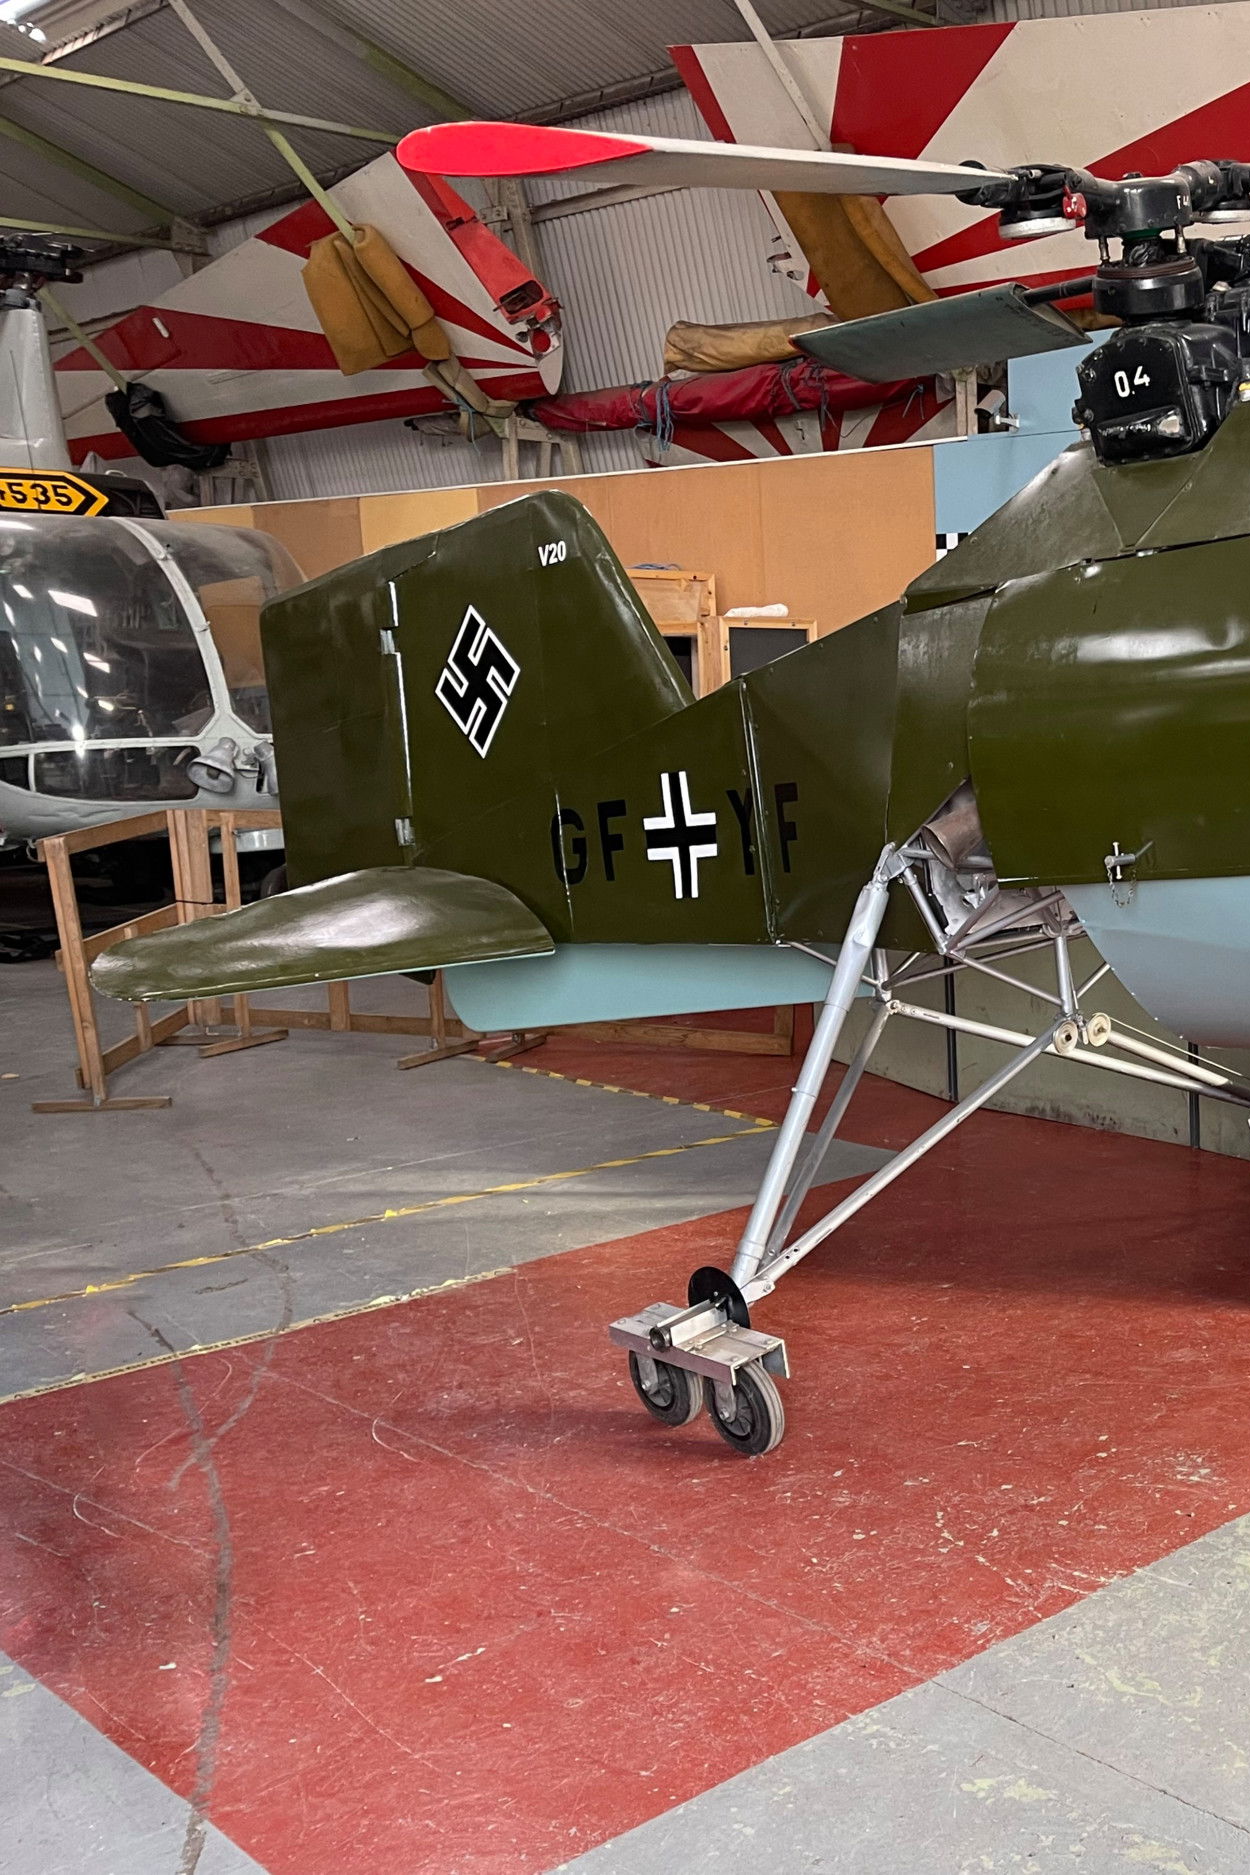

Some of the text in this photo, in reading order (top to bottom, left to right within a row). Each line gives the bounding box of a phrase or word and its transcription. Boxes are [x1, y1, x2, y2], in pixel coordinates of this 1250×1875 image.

[537, 540, 567, 567] V20
[550, 782, 798, 886] GF YF
